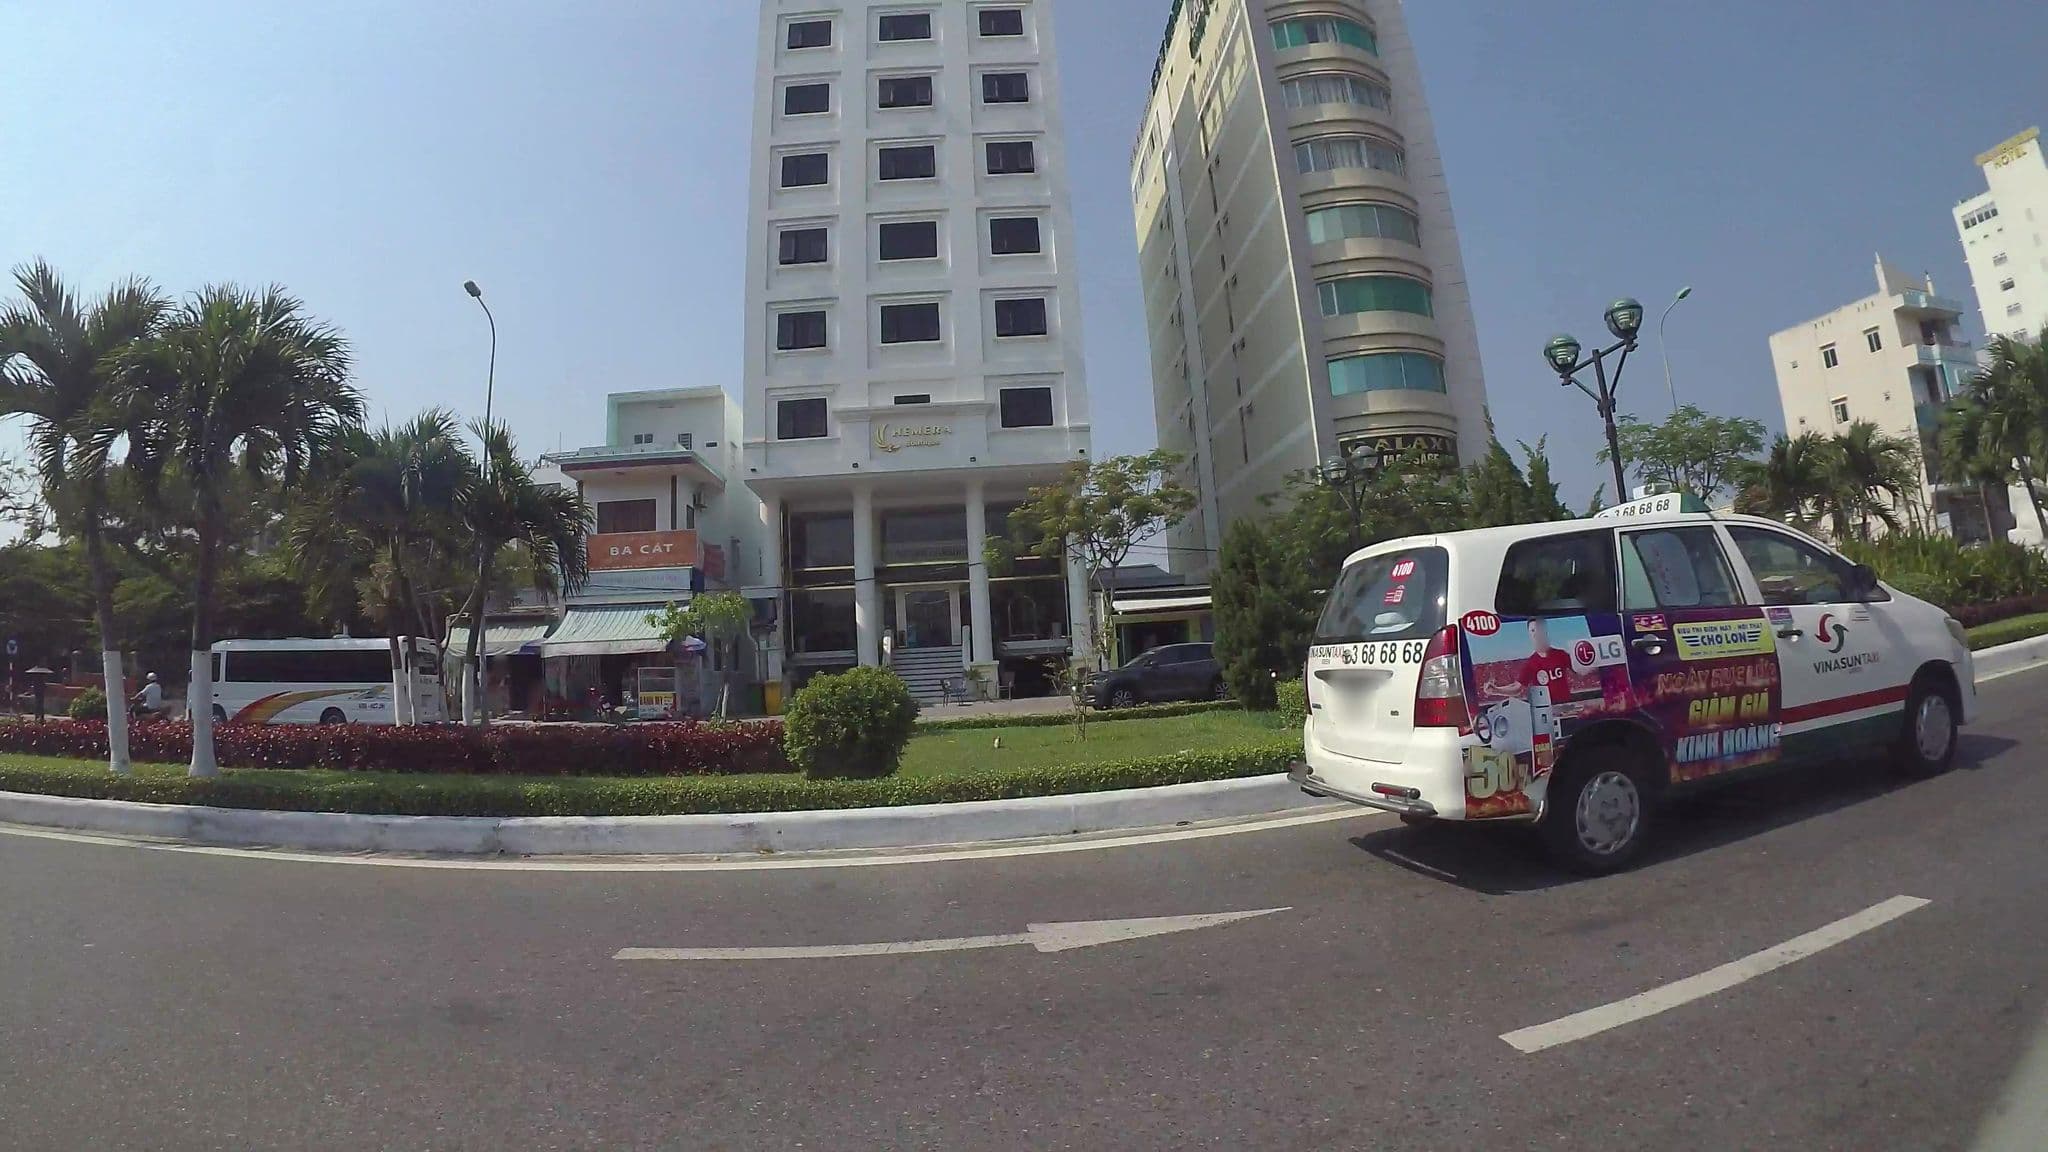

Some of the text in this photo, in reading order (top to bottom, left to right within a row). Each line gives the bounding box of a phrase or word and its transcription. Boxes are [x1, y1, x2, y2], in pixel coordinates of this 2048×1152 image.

[1994, 147, 2028, 169] HOTEL
[1639, 502, 1652, 515] 68
[1656, 499, 1670, 512] 68
[610, 546, 632, 556] BA
[1466, 615, 1496, 631] 4100
[1362, 644, 1376, 665] 68
[1380, 642, 1397, 663] 68
[1403, 642, 1423, 663] 68
[1600, 641, 1621, 660] LG
[1549, 667, 1563, 680] LG
